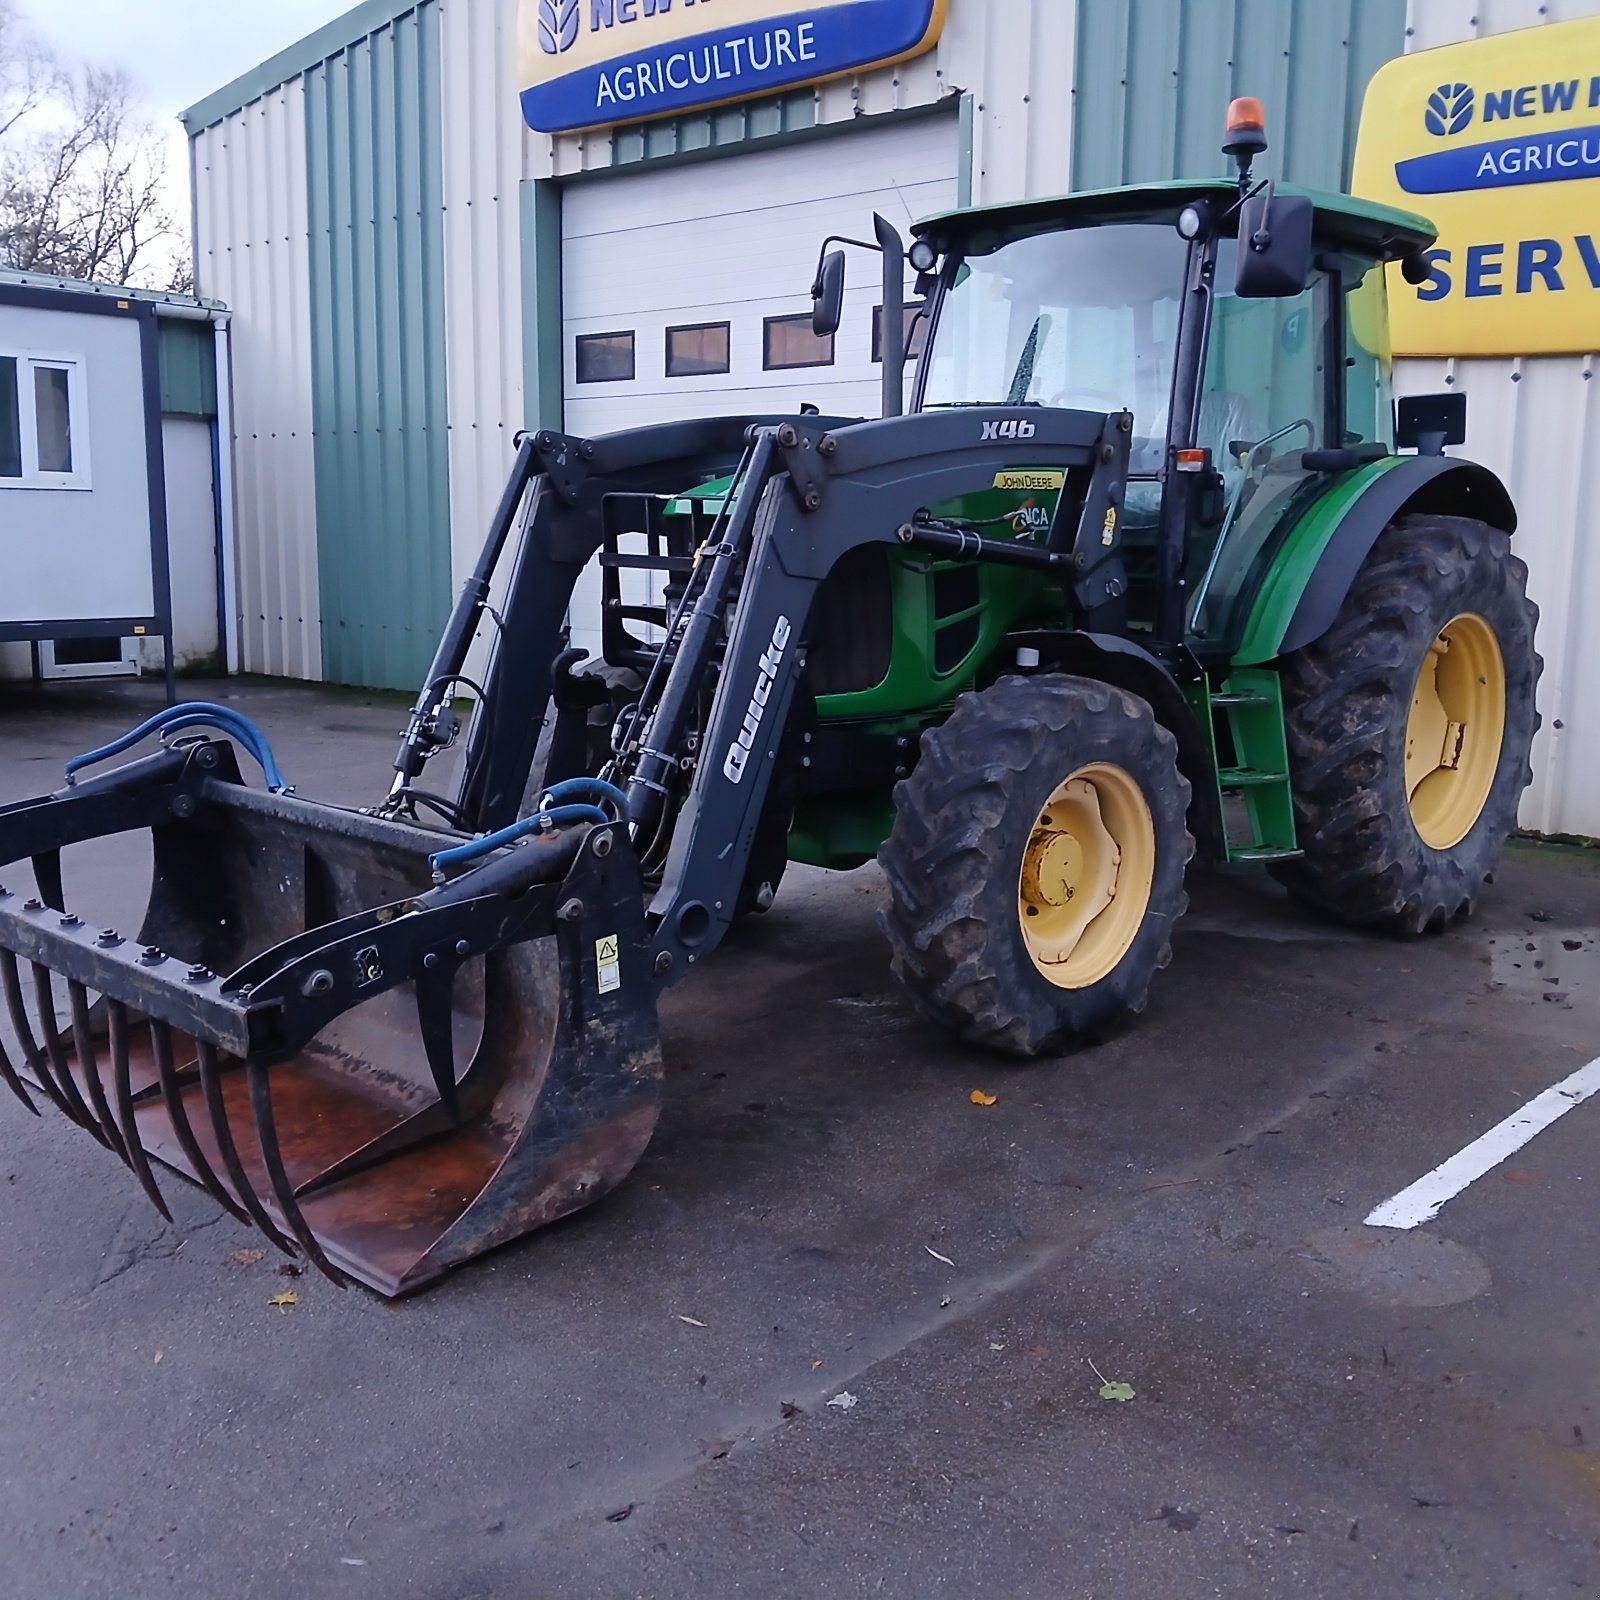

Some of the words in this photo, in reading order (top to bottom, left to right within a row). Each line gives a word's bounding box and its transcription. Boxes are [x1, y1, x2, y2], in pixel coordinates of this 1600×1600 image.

[597, 22, 816, 107] AGRICULTURE
[1483, 79, 1579, 122] NEW
[1476, 139, 1600, 178] AGRICU
[980, 420, 1036, 440] X46
[1002, 475, 1024, 488] JOHN
[1025, 475, 1053, 488] DEERE
